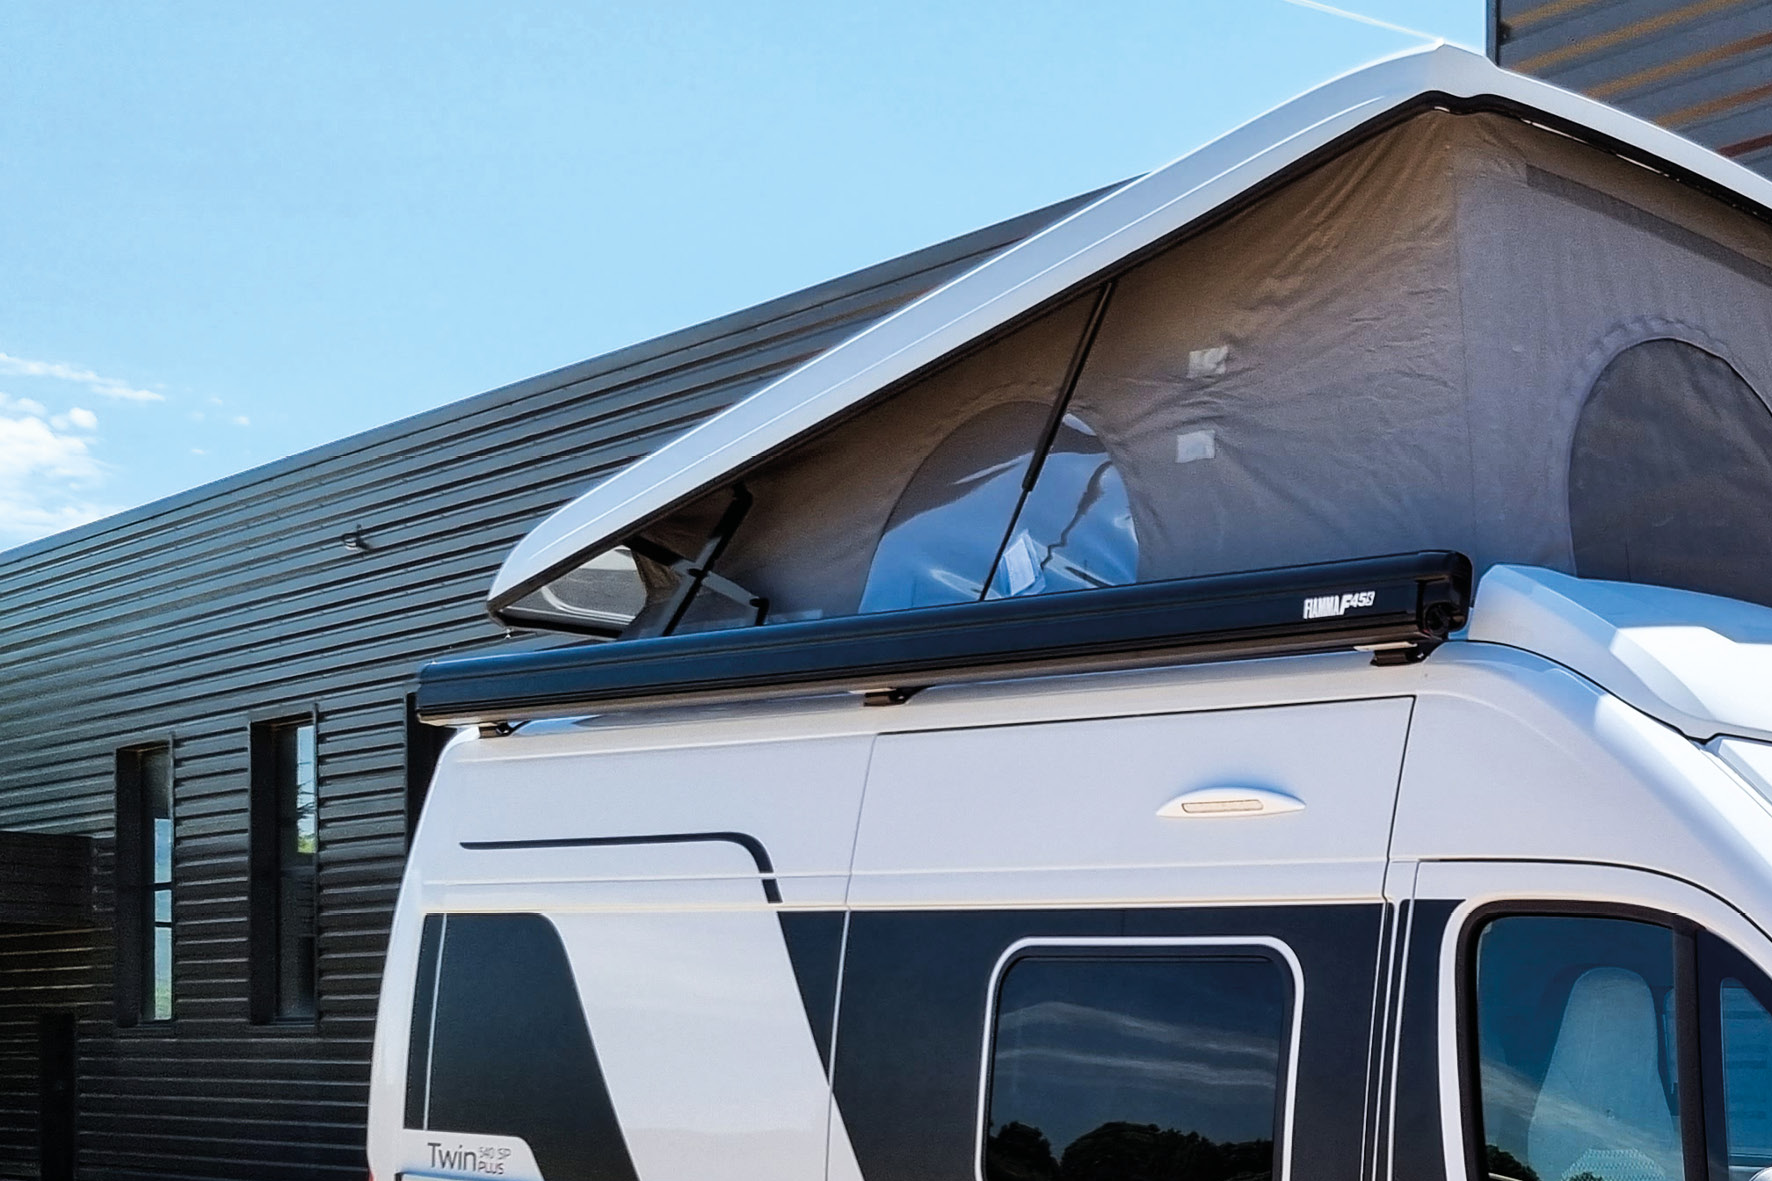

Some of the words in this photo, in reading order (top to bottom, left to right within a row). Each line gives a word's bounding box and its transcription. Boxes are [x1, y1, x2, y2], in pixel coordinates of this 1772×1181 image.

[1303, 595, 1340, 619] FIAMMA
[427, 1142, 477, 1172] Twin
[498, 1147, 512, 1160] SP
[478, 1161, 505, 1175] PLUS
